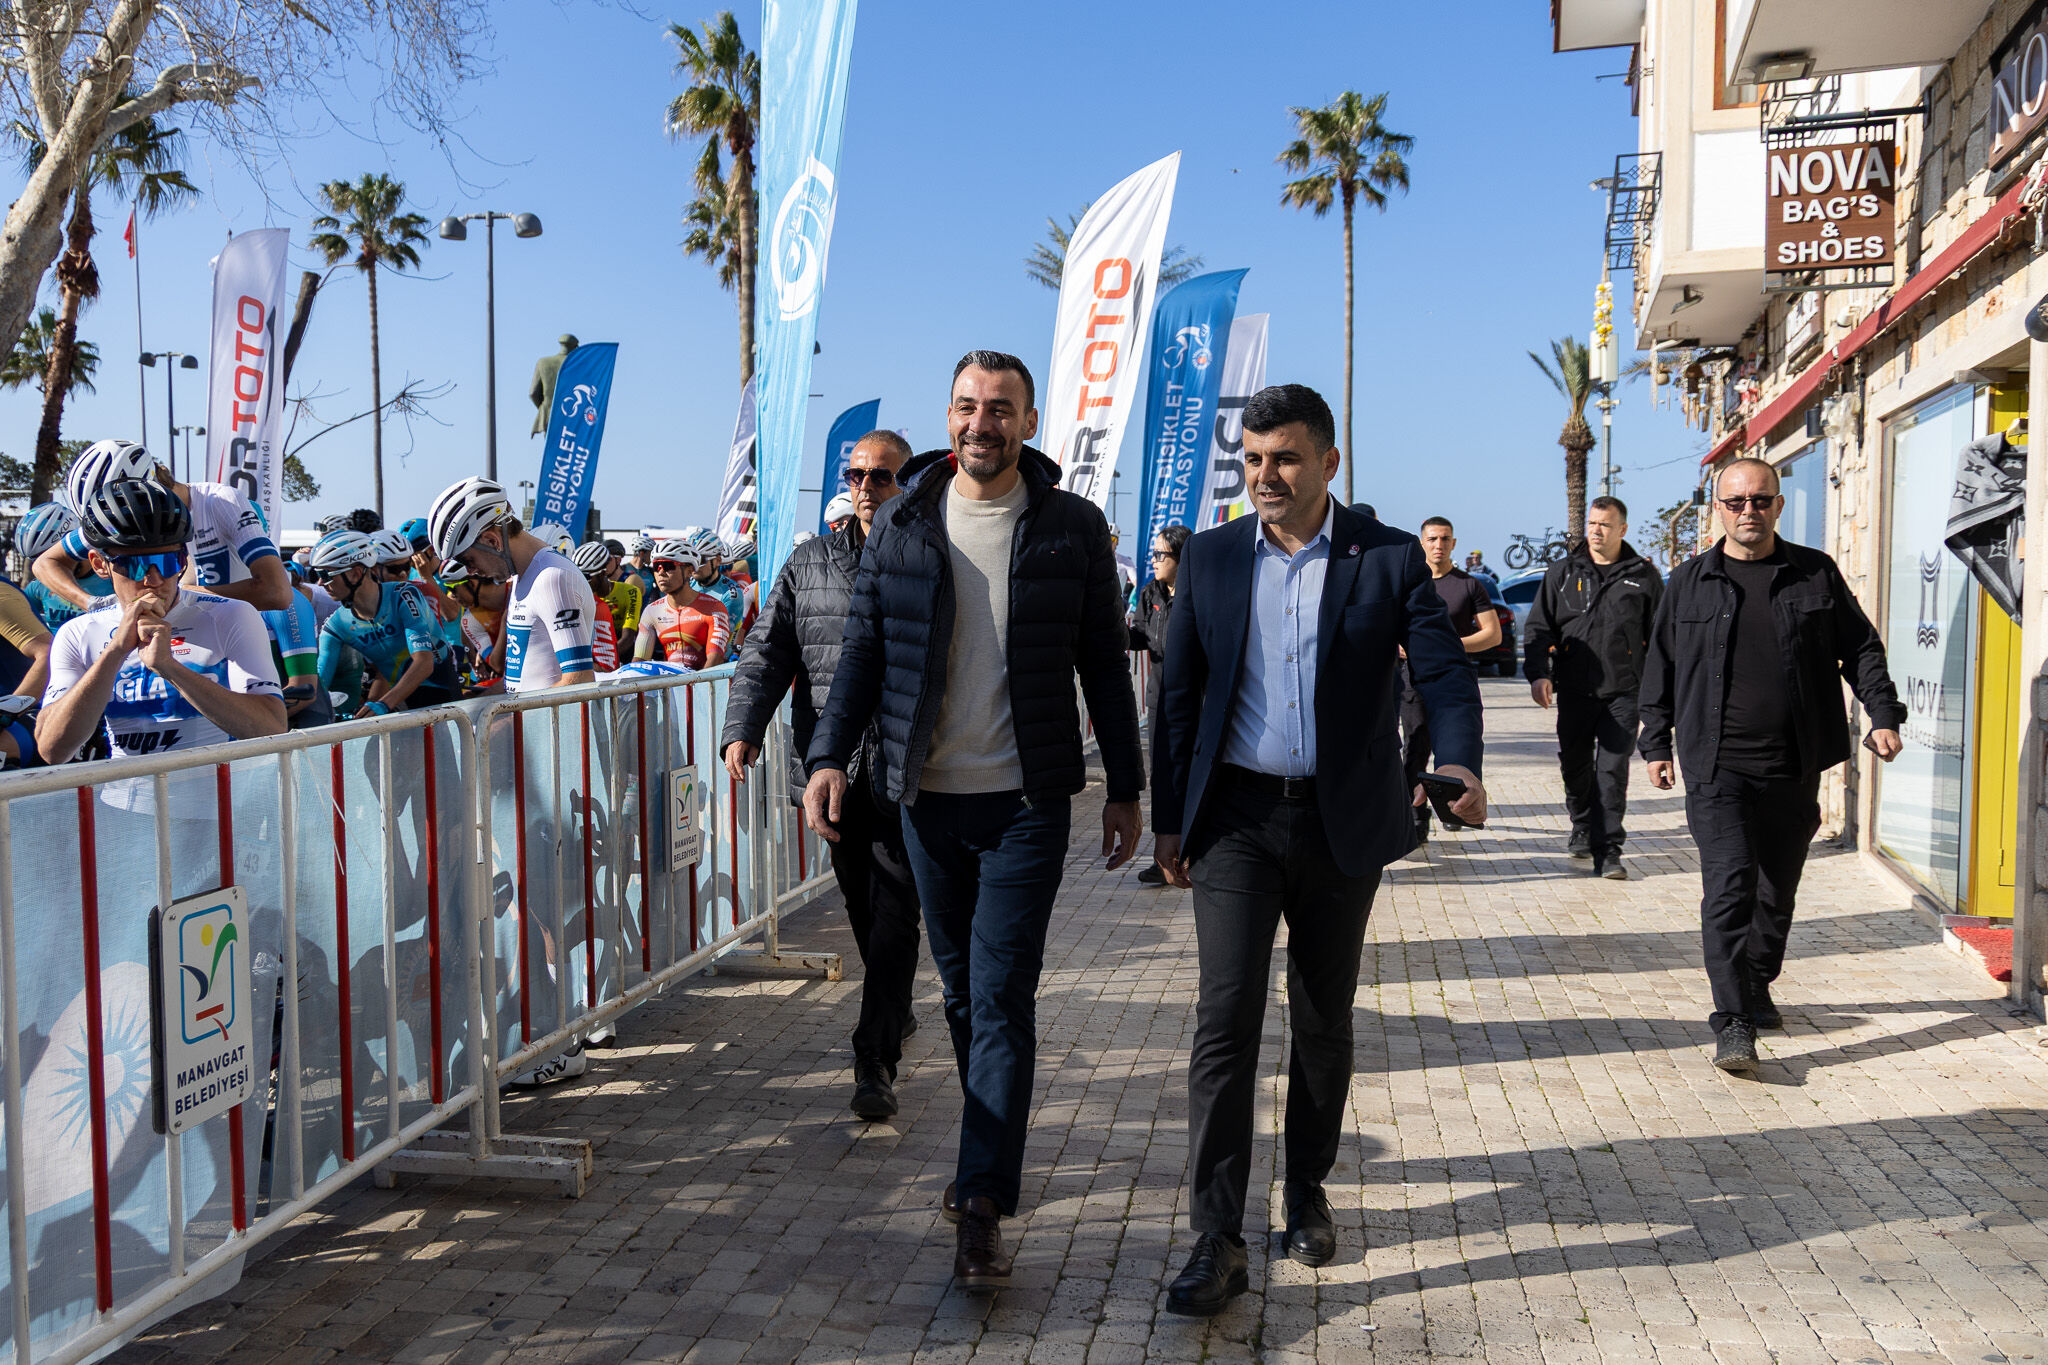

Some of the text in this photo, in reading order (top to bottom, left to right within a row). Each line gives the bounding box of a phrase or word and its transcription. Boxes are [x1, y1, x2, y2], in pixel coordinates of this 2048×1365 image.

[1992, 31, 2048, 154] NO
[1770, 147, 1891, 197] NOVA
[1782, 194, 1880, 224] BAG'S
[1820, 221, 1840, 238] &
[1778, 235, 1884, 264] SHOES
[229, 295, 265, 501] ORTOTO
[1069, 257, 1132, 496] ORTOTO
[1157, 380, 1184, 479] BİSİKLET
[545, 426, 577, 513] BİSİKLET
[1167, 397, 1203, 527] DERASYONU
[563, 446, 590, 528] ASYONU
[593, 620, 616, 669] ANTA
[1906, 675, 1947, 722] NOVA
[673, 846, 698, 864] BELEDİYESİ
[675, 834, 697, 850] MANAVGAT
[174, 1067, 249, 1116] BELEDİYESİ
[176, 1045, 246, 1089] MANAVGAT
